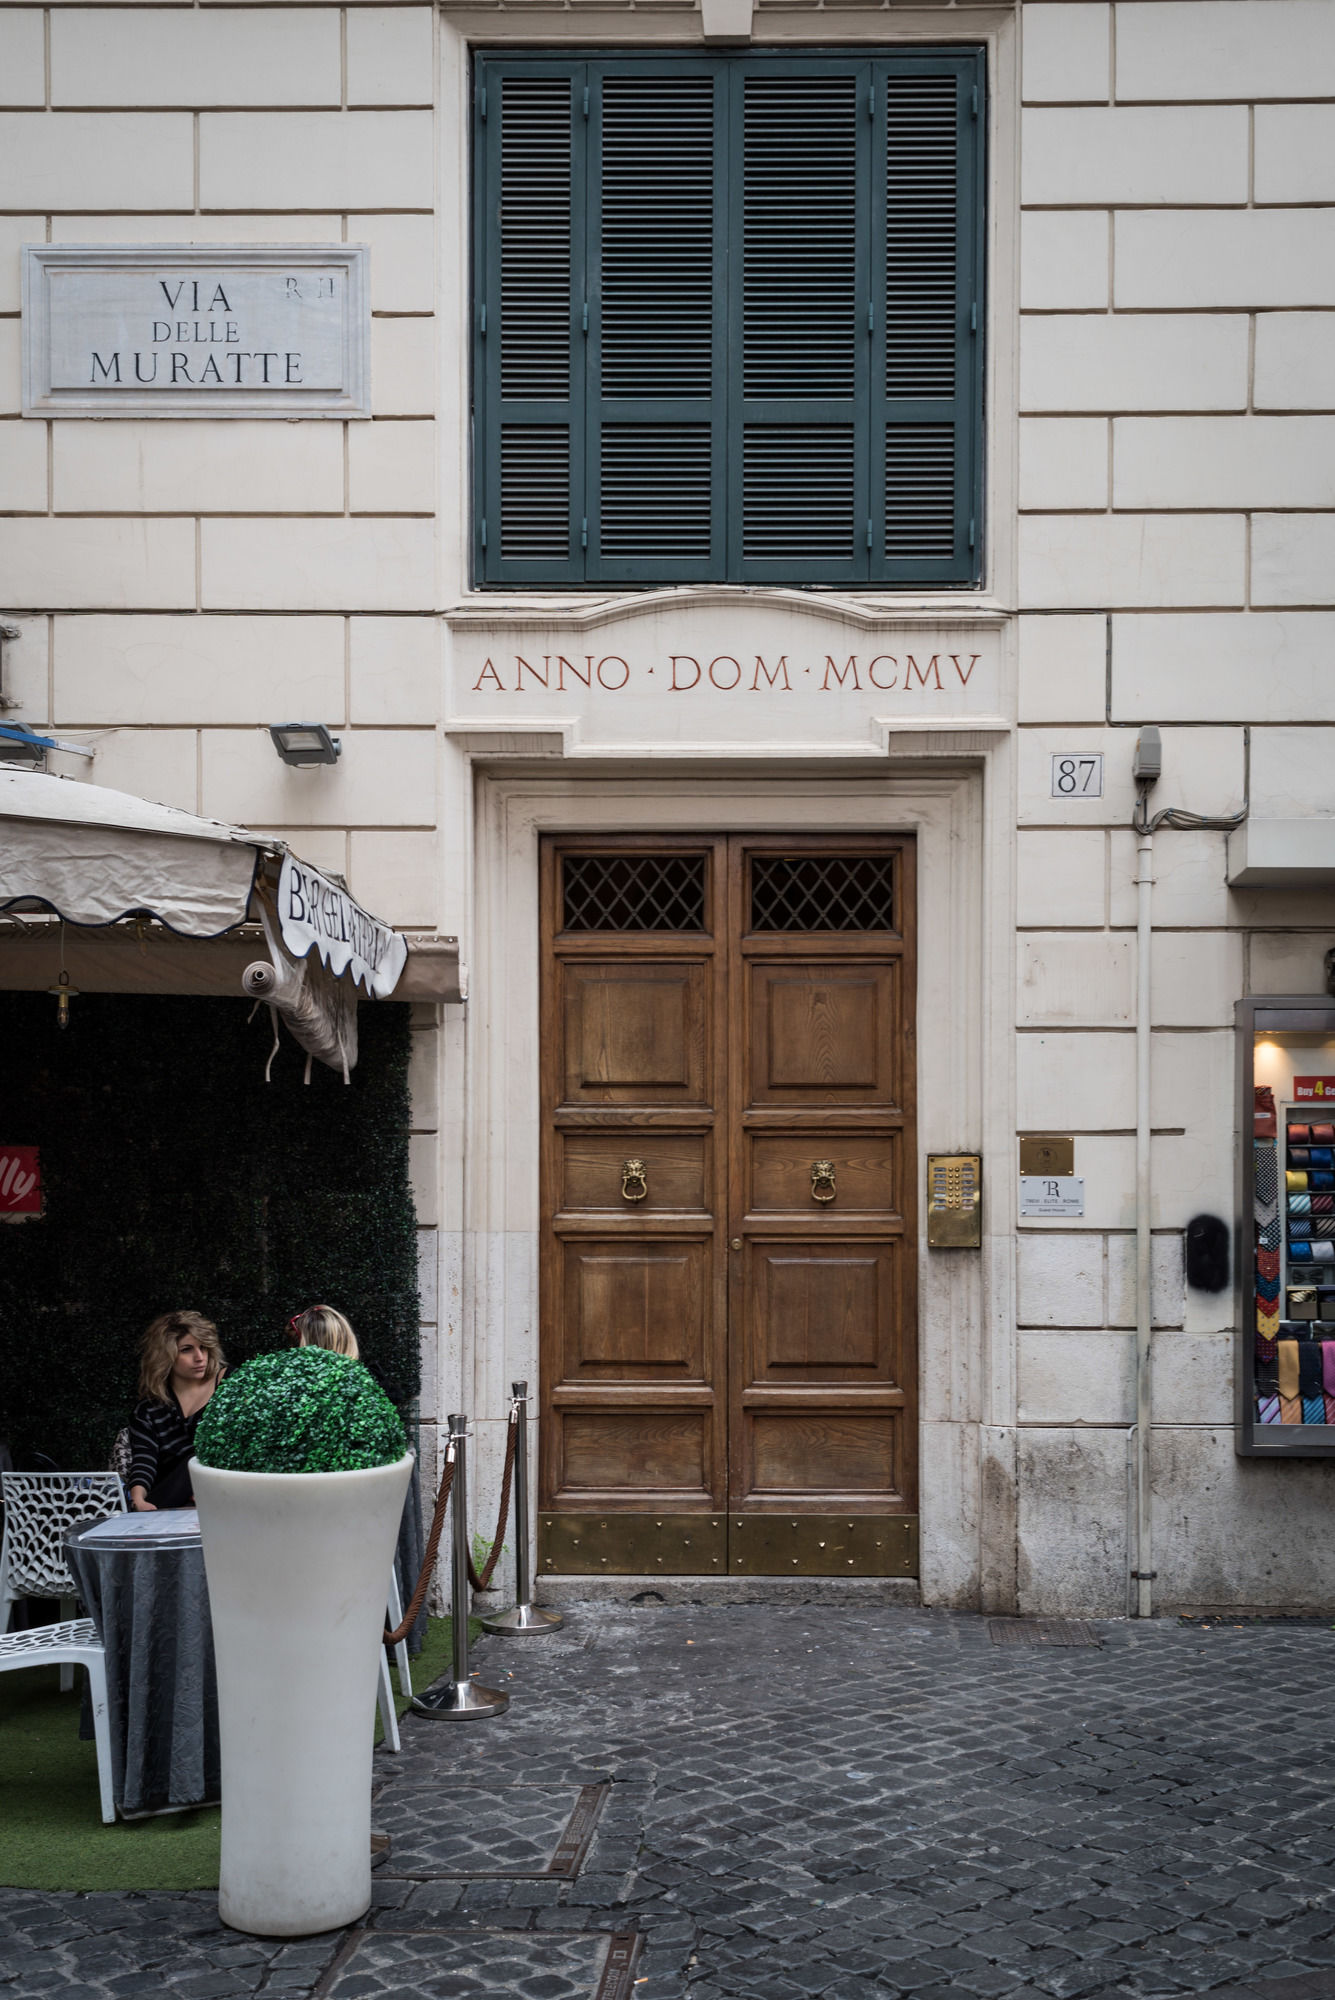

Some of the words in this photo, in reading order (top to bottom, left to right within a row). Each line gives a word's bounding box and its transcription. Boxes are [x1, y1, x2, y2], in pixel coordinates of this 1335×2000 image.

[159, 281, 233, 312] VIA
[285, 277, 303, 299] R
[152, 321, 241, 343] DELLE
[89, 352, 304, 383] MURATTE
[471, 655, 630, 691] ANNO
[667, 655, 793, 691] DOM
[818, 654, 983, 691] MCMV
[1058, 759, 1096, 793] 87
[1297, 1086, 1314, 1097] Buy
[1314, 1080, 1324, 1096] 4
